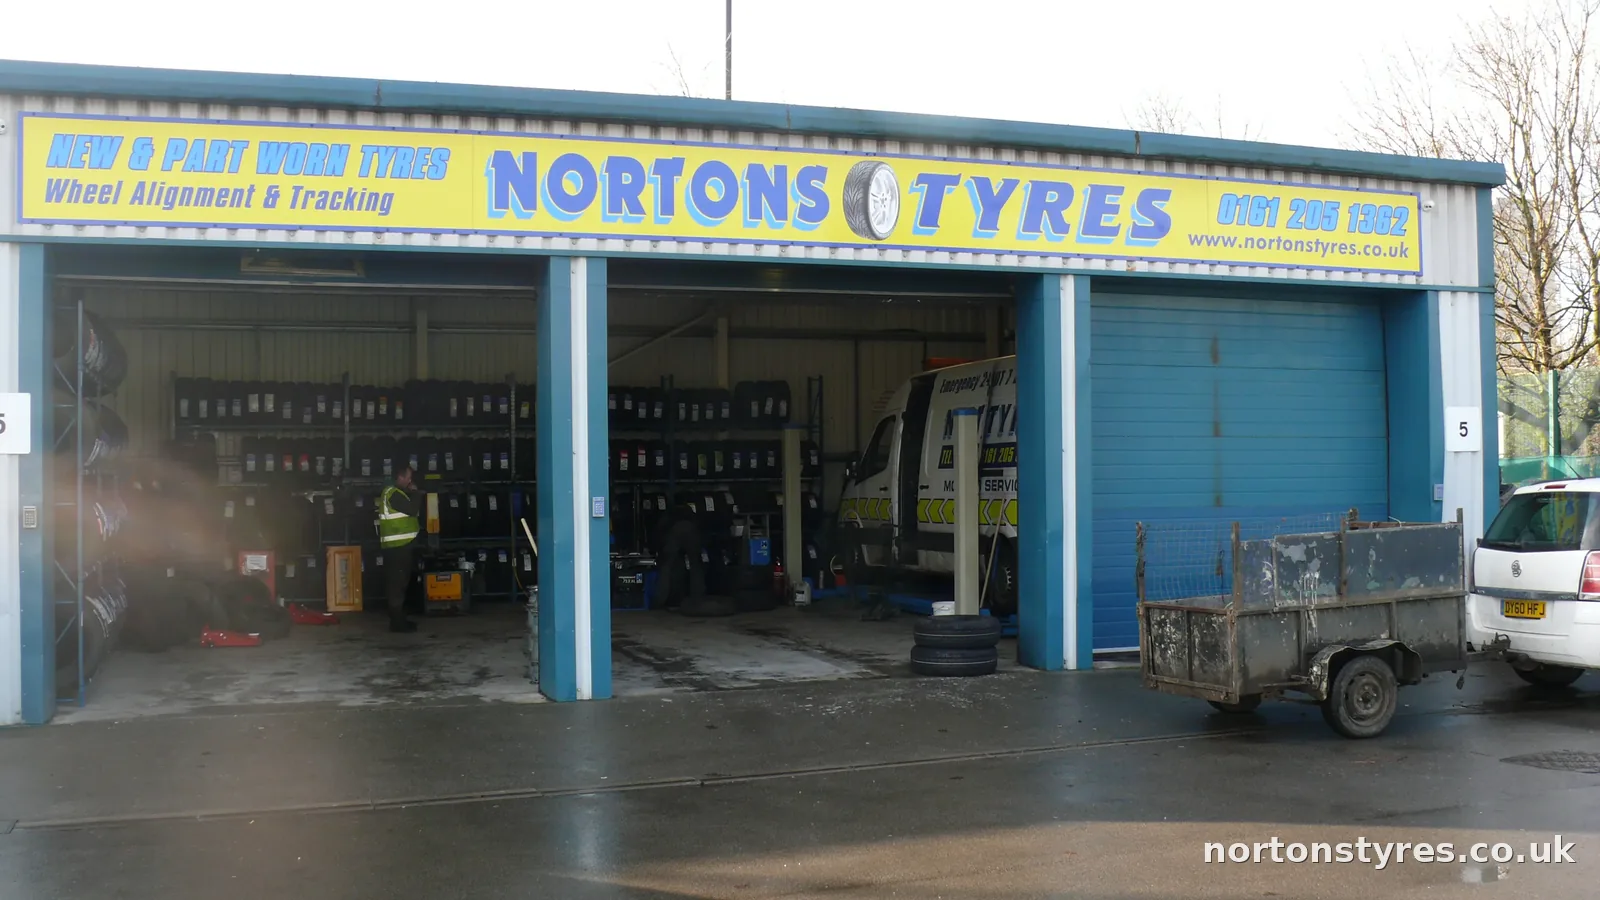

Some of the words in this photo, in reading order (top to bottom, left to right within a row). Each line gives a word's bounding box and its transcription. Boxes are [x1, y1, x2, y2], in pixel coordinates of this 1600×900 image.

[46, 134, 124, 169] NEW
[128, 137, 155, 171] &
[162, 138, 249, 174] PART
[256, 141, 350, 178] WORN
[358, 145, 451, 180] TYRES
[45, 178, 124, 206] Wheel
[129, 181, 256, 212] Alignment
[263, 185, 280, 210] &
[290, 186, 394, 216] Tracking
[487, 150, 829, 231] NORTONS
[908, 172, 1173, 247] TYRES
[1217, 193, 1280, 227] 0161
[1286, 198, 1340, 231] 205
[1347, 203, 1409, 236] 1362
[1188, 233, 1408, 258] www.nortonstyres.co.uk
[940, 377, 980, 393] Emergency
[1459, 421, 1468, 437] 5
[998, 447, 1015, 462] 205
[1505, 600, 1525, 615] DY60
